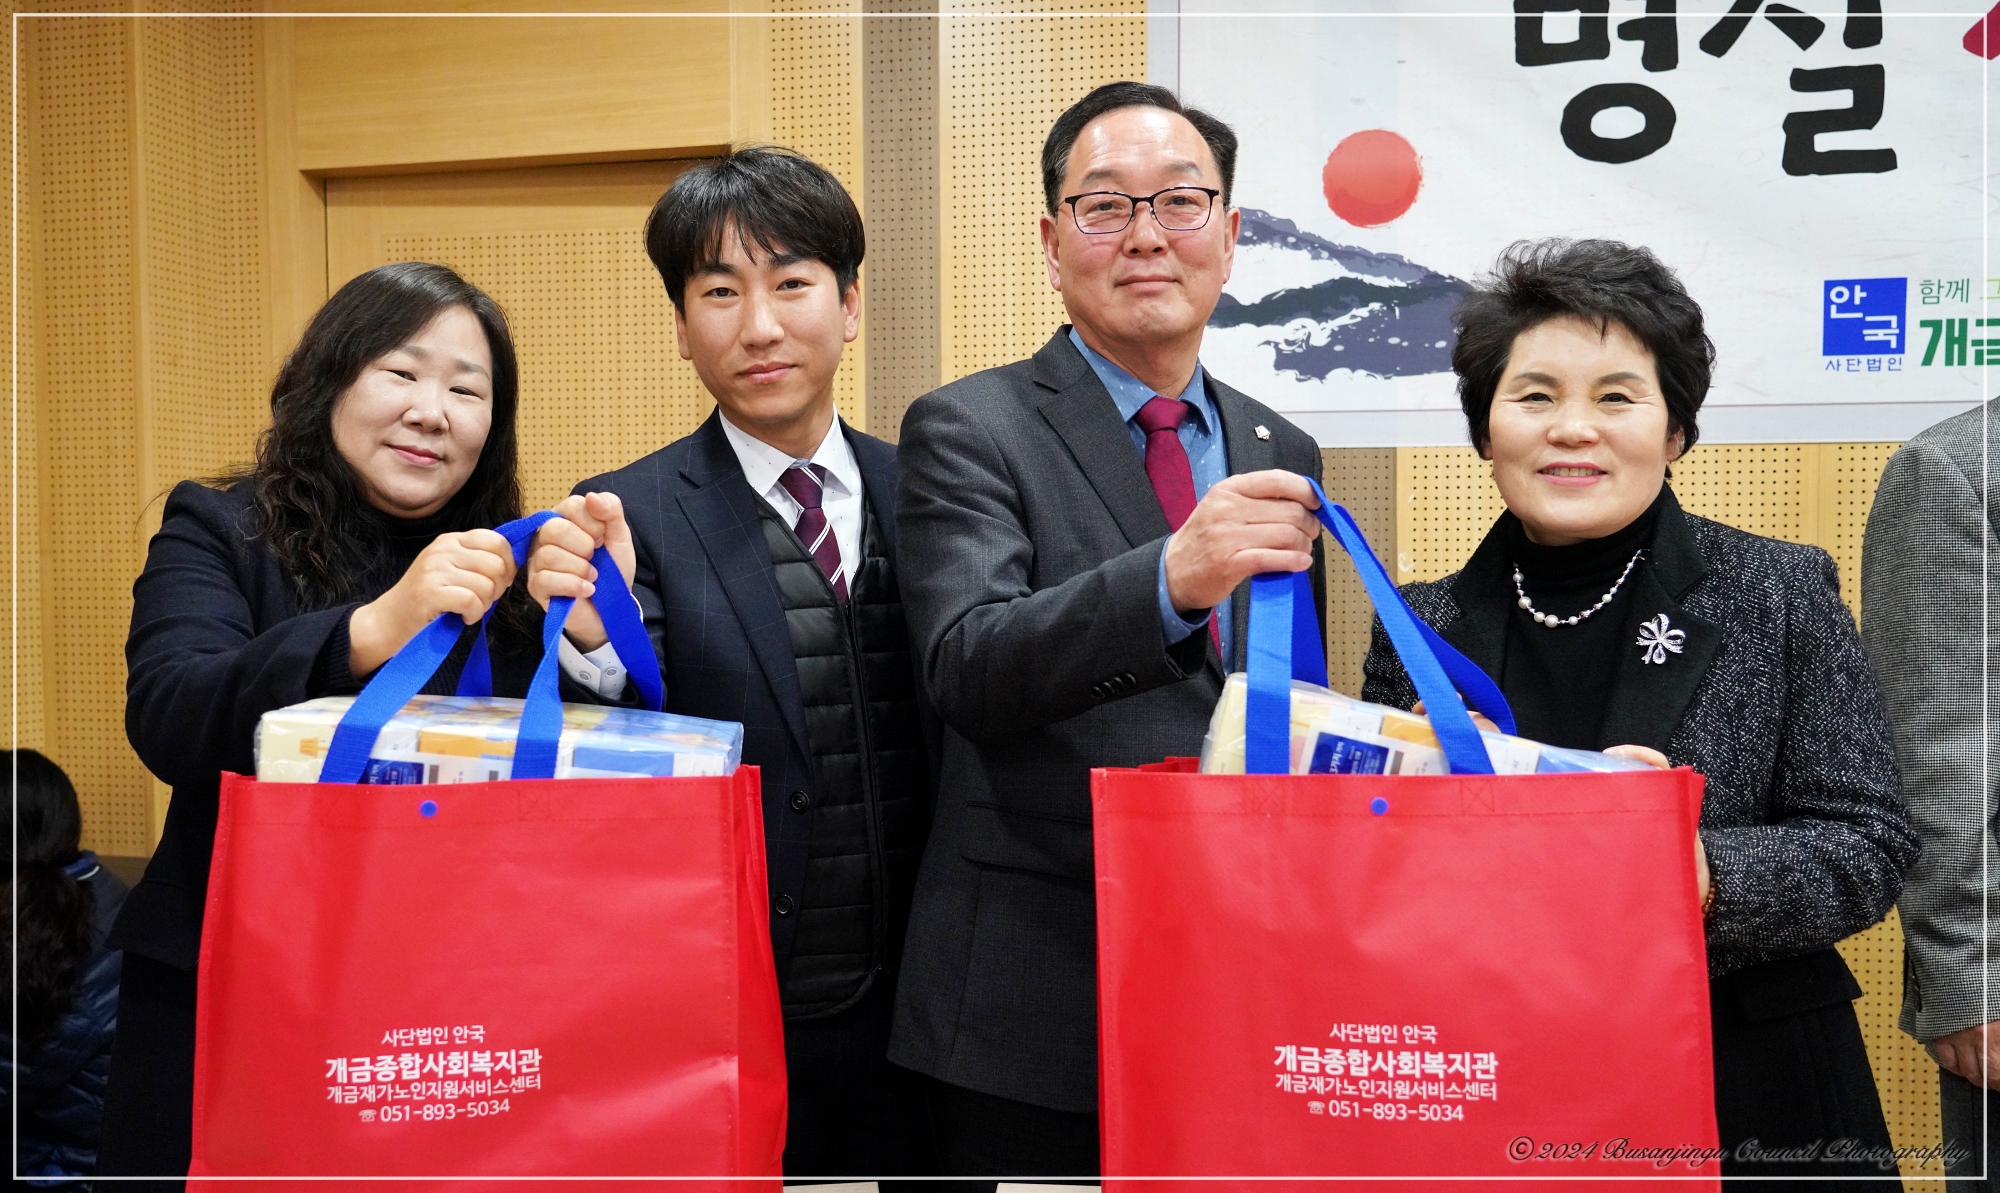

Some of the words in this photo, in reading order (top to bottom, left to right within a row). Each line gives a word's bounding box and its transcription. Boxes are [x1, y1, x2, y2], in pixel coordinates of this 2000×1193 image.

[1919, 278, 1970, 305] 함께
[1829, 284, 1900, 349] 안국
[1825, 357, 1902, 372] 사단법인
[381, 1026, 449, 1047] 사단법인
[452, 1025, 486, 1043] 안국
[1329, 1023, 1398, 1043] 사단법인
[1402, 1025, 1438, 1044] 안국
[325, 1048, 542, 1083] 개금종합사회복지관
[1273, 1045, 1498, 1079] 개금종합사회복지관
[327, 1074, 541, 1104] 개금재가노인지원서비스센터
[1275, 1073, 1498, 1101] 개금재가노인지원서비스센터
[380, 1098, 511, 1122] 051-893-5034
[1328, 1099, 1464, 1121] 051-893-5034
